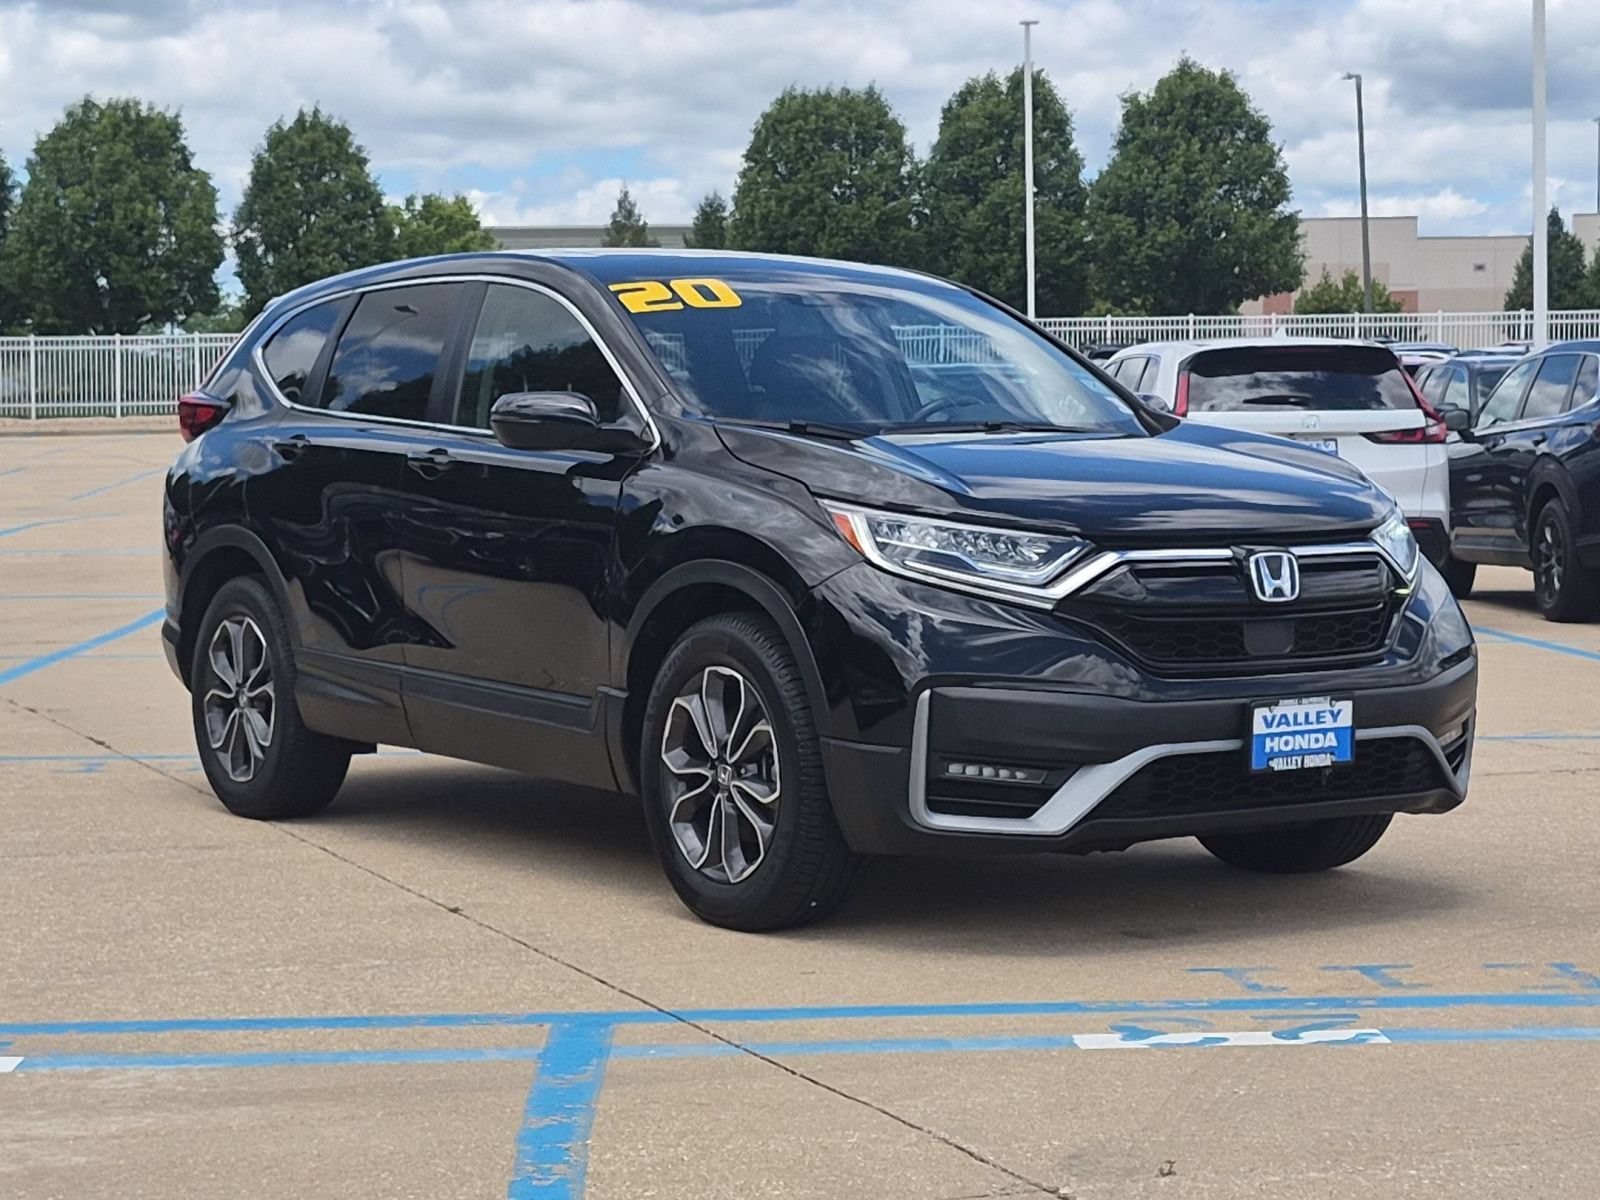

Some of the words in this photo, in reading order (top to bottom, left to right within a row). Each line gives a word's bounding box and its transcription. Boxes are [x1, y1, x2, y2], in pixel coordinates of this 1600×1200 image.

[608, 278, 742, 313] 20
[1262, 708, 1343, 729] VALLEY
[1264, 731, 1338, 753] HONDA
